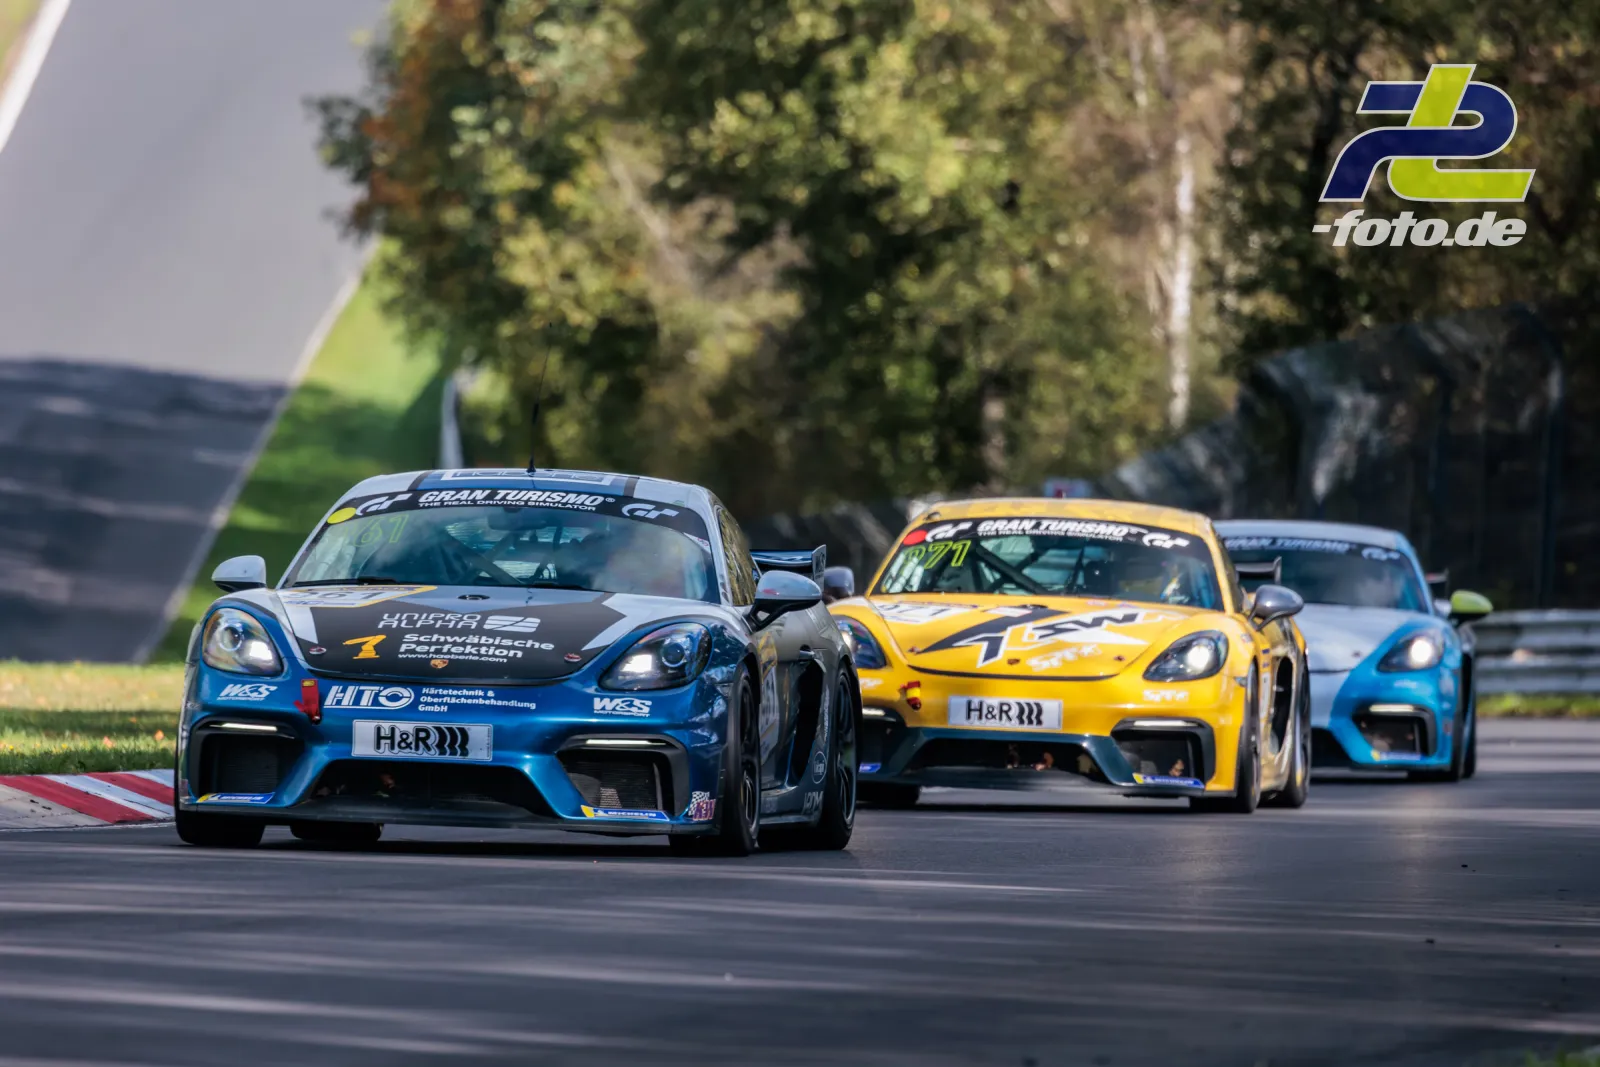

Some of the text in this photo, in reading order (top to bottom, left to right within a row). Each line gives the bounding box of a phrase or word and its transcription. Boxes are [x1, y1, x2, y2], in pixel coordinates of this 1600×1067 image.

[418, 489, 490, 503] GRAN
[528, 502, 596, 512] SIMULATOR
[977, 519, 1037, 532] GRAN
[383, 612, 482, 621] UNIPRO
[377, 619, 478, 629] ALPHA
[402, 633, 555, 650] Schwäbische
[399, 643, 523, 658] Perfektion
[324, 685, 415, 709] HTO
[422, 687, 495, 697] Härtetechnik &
[418, 704, 448, 712] GmbH
[420, 696, 536, 710] Oberflächenbehandlung
[593, 697, 652, 712] W&S
[966, 700, 1014, 722] H&R
[375, 725, 431, 752] H&R
